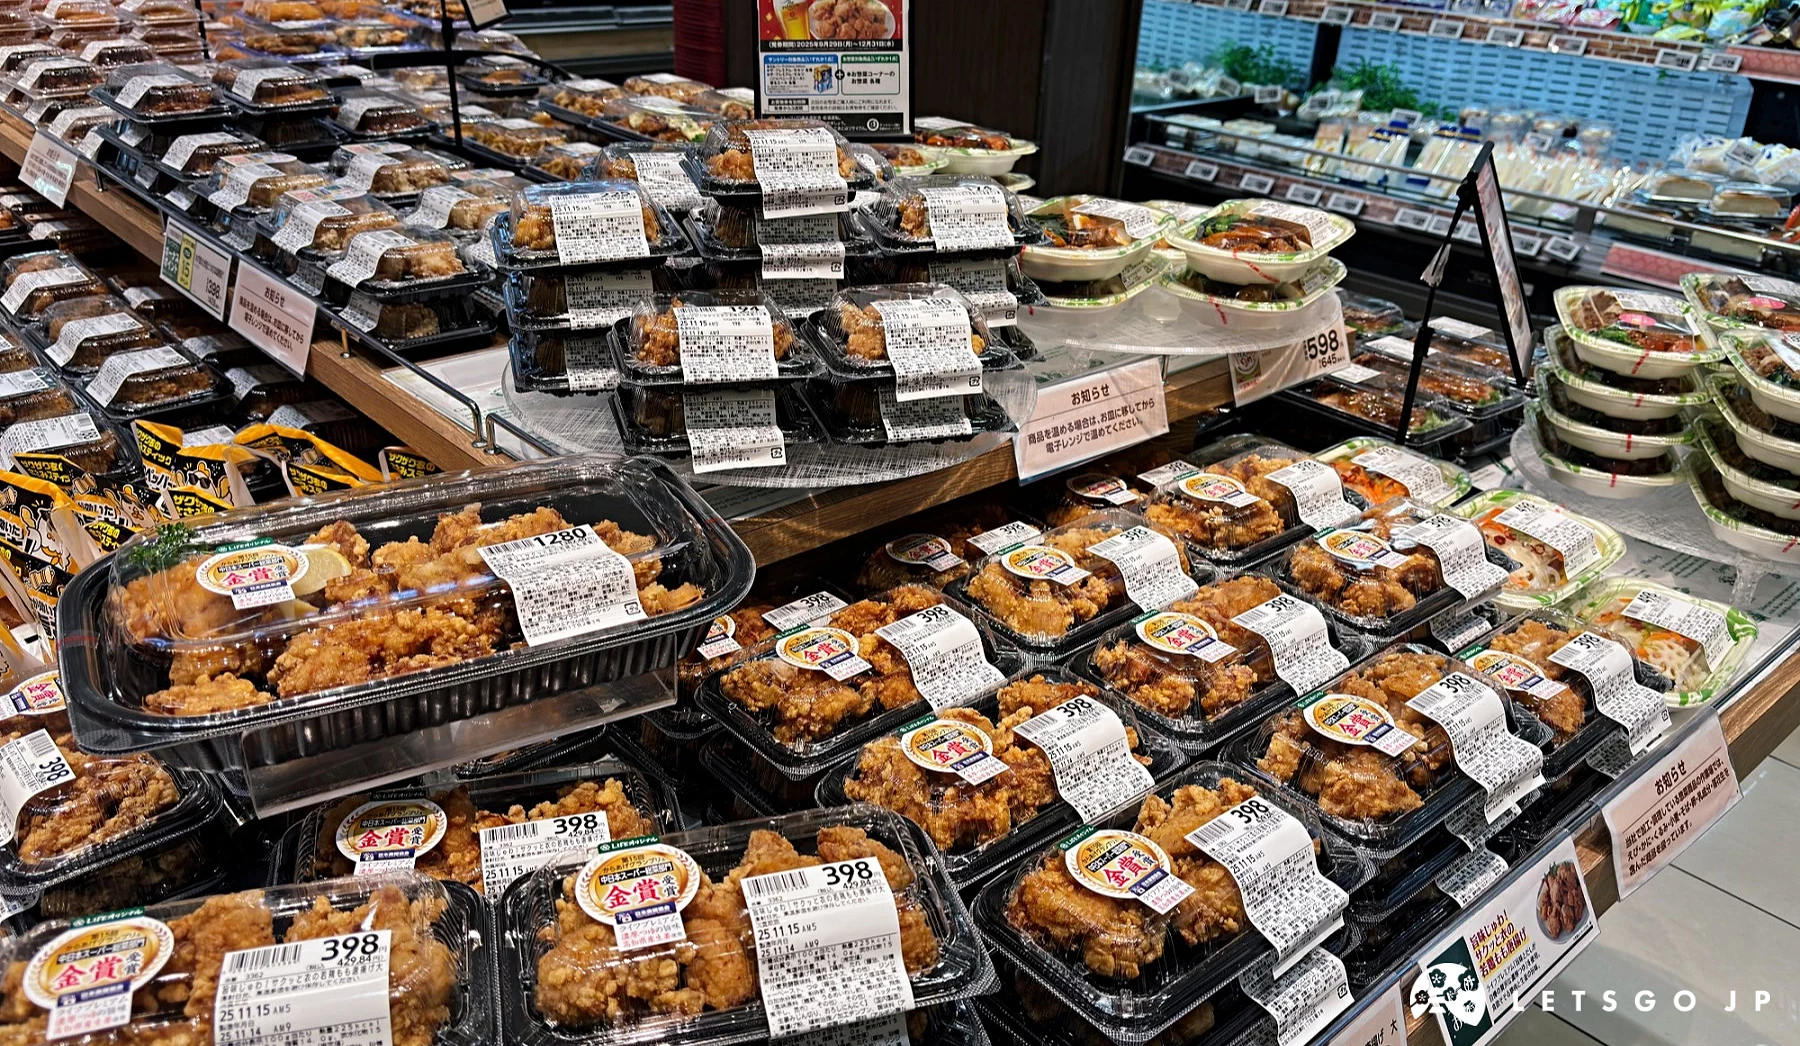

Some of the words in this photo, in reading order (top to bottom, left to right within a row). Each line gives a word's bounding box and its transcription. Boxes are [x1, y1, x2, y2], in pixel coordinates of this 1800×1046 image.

[265, 287, 286, 307] お知らせ
[1308, 330, 1339, 359] 598
[1322, 353, 1336, 367] 645
[1071, 384, 1110, 405] お知らせ
[1028, 398, 1155, 445] 商品を温める場合は、お皿に移してから
[1046, 418, 1144, 453] 電子レンジで温めてください。
[534, 528, 587, 546] 1280
[999, 522, 1026, 536] 398
[1119, 528, 1148, 542] 398
[222, 567, 272, 586] 金賞
[800, 594, 831, 608] 398
[1264, 596, 1295, 613] 398
[916, 606, 949, 623] 398
[1164, 628, 1202, 648] 金賞
[1573, 632, 1601, 649] 398
[802, 641, 840, 663] 金賞
[1439, 674, 1471, 694] 398
[1056, 697, 1092, 717] 398
[1338, 714, 1375, 737] 金賞
[932, 740, 972, 764] 金賞
[39, 756, 70, 781] 398
[1655, 759, 1687, 795] お知らせ
[1230, 799, 1269, 824] 398
[554, 814, 598, 834] 398
[359, 827, 409, 848] 金賞
[410, 826, 423, 845] 受賞
[611, 837, 658, 849] LIFEオリジナル
[822, 861, 872, 886] 398
[1103, 856, 1148, 887] 金賞
[604, 878, 661, 908] 金賞
[662, 875, 677, 897] 受賞
[802, 923, 817, 933] AM5
[1470, 909, 1508, 950] 旨味じゅわ!
[321, 933, 379, 961] 398
[804, 939, 819, 949] AM9
[1475, 922, 1515, 963] サクッと衣の
[1479, 926, 1528, 978] 若鶏もも唐揚げ
[53, 956, 123, 991] 金賞
[273, 1004, 291, 1014] AM5
[273, 1023, 292, 1032] AM9
[1390, 1018, 1398, 1034] 大
